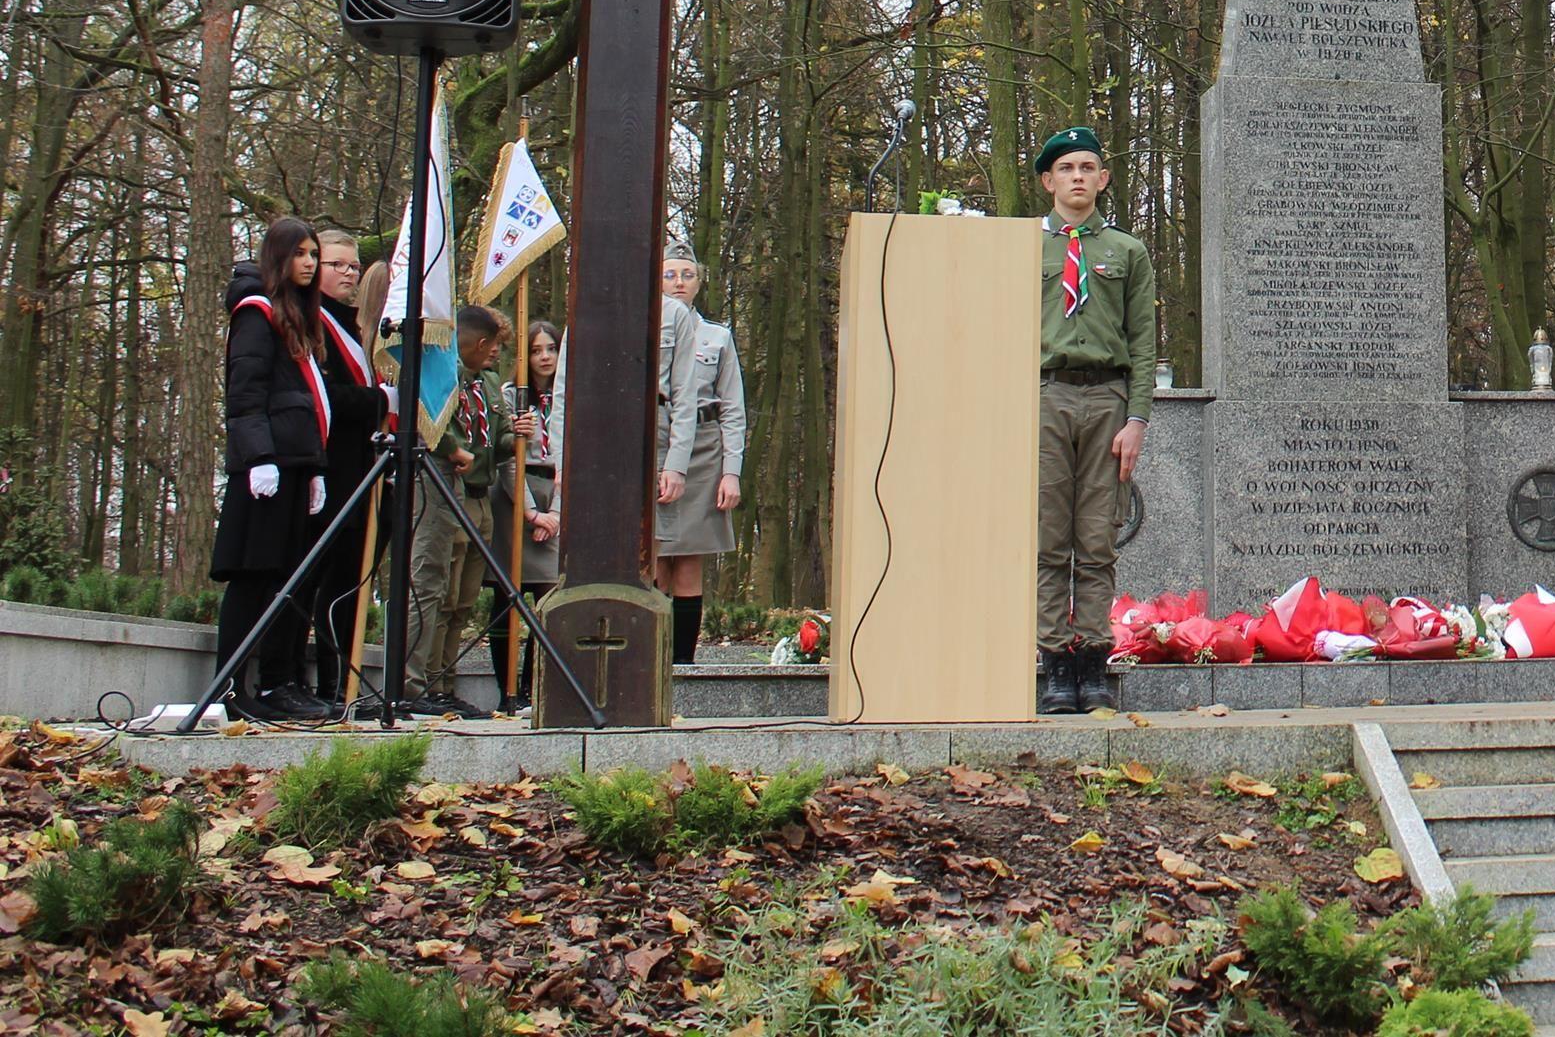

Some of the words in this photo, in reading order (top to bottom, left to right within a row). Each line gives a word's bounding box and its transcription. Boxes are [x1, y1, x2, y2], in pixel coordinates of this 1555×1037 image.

[1288, 1, 1314, 14] POD
[1318, 48, 1350, 61] 1920
[1336, 103, 1391, 115] ZYGMUNT
[1258, 199, 1325, 211] GRABOWSKI
[1297, 220, 1326, 230] KARP
[1342, 242, 1415, 253] ALEKSANDER
[1267, 260, 1330, 270] MAKOWSKI
[1335, 261, 1399, 272] BRONISŁAW
[1263, 280, 1365, 292] MIKOŁAJCZEWSKI
[1267, 300, 1354, 311] PRZYBOJEWSKI
[1360, 302, 1404, 312] ANTONI
[1350, 342, 1396, 352] TEODOR
[1301, 419, 1344, 431] ROKU
[1284, 440, 1343, 451] MIASTO
[1268, 460, 1361, 472] BOHATEROM
[1370, 460, 1412, 471] WALK
[1247, 481, 1257, 493] O
[1355, 479, 1435, 493] OJCZYZNY
[1251, 502, 1264, 513] W
[1303, 522, 1380, 535] ODPARCIA
[1232, 543, 1306, 556] NAJAZDU
[1312, 543, 1450, 556] BOLSZEWICKIEGO
